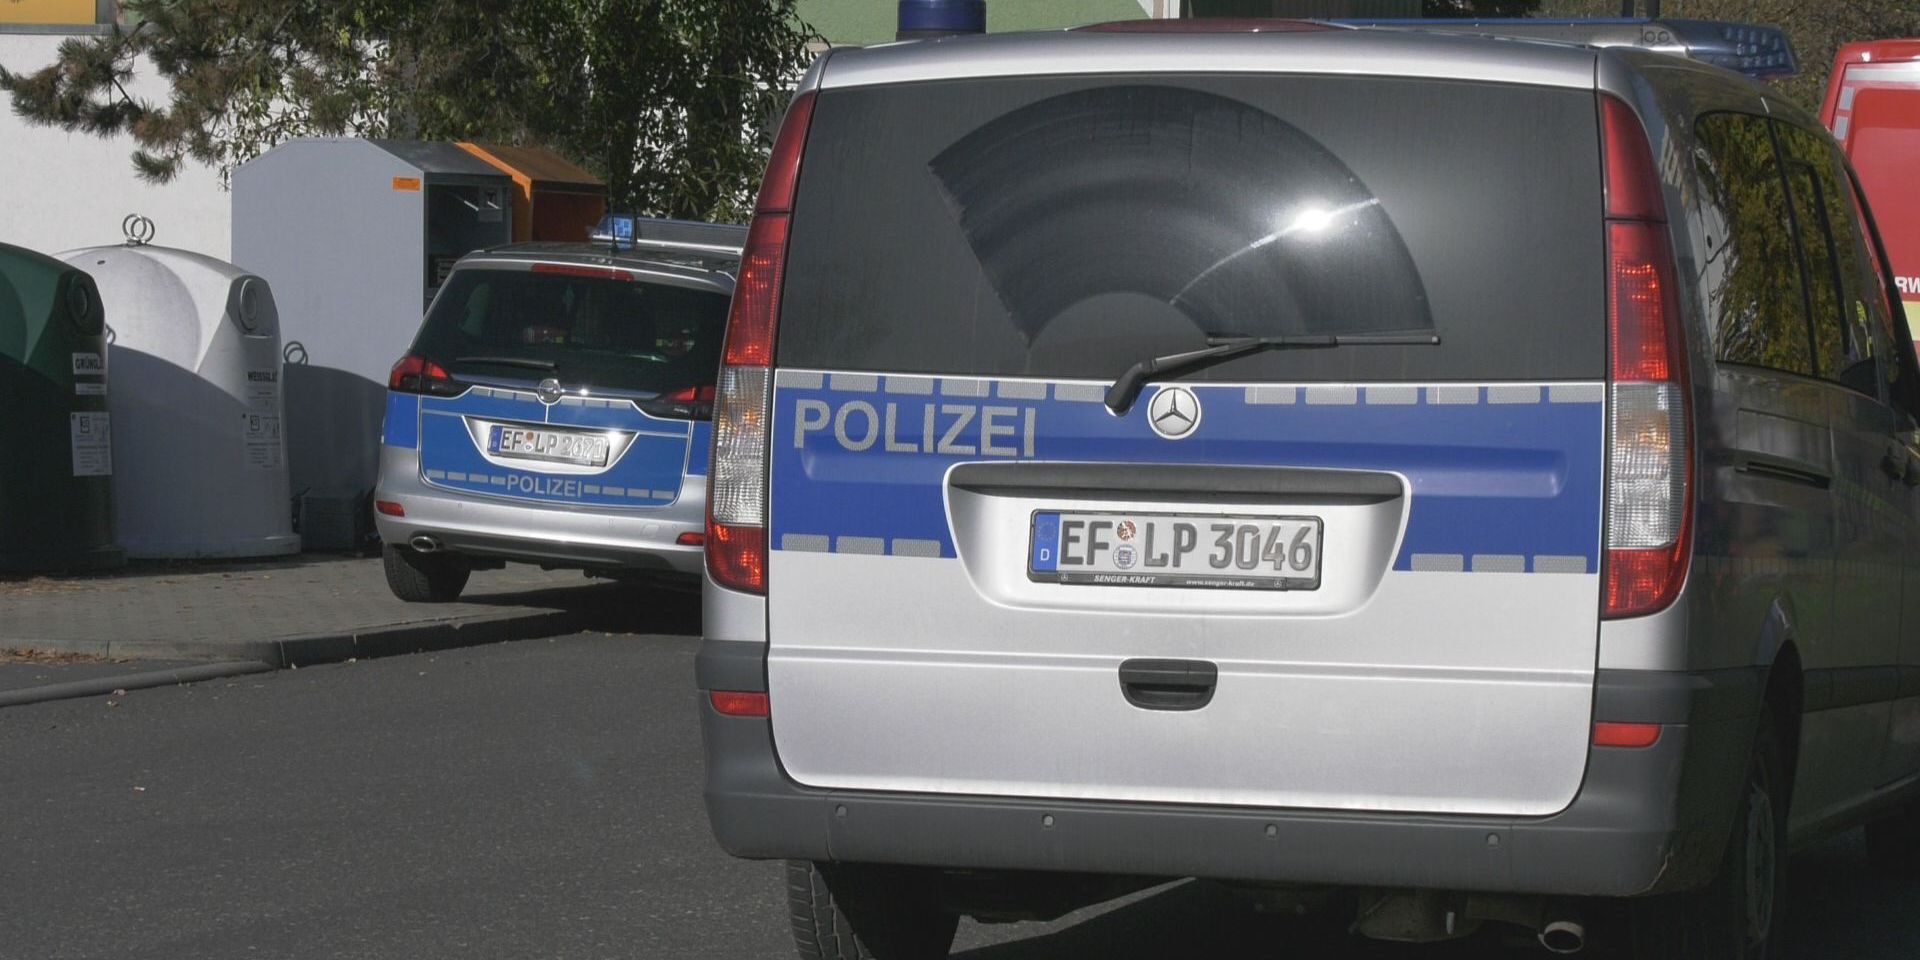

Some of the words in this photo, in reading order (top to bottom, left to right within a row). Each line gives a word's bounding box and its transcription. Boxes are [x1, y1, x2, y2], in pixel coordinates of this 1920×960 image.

[794, 399, 1036, 457] POLIZEI
[501, 430, 524, 450] EF
[535, 433, 558, 455] LP
[507, 474, 582, 497] POLIZEI
[1040, 548, 1050, 561] D
[1060, 521, 1113, 565] EF
[1144, 522, 1197, 568] LP
[1209, 523, 1312, 571] 3046
[1093, 574, 1156, 584] SENGER-KRAFT
[1186, 579, 1255, 588] www.senger-kraft.de
